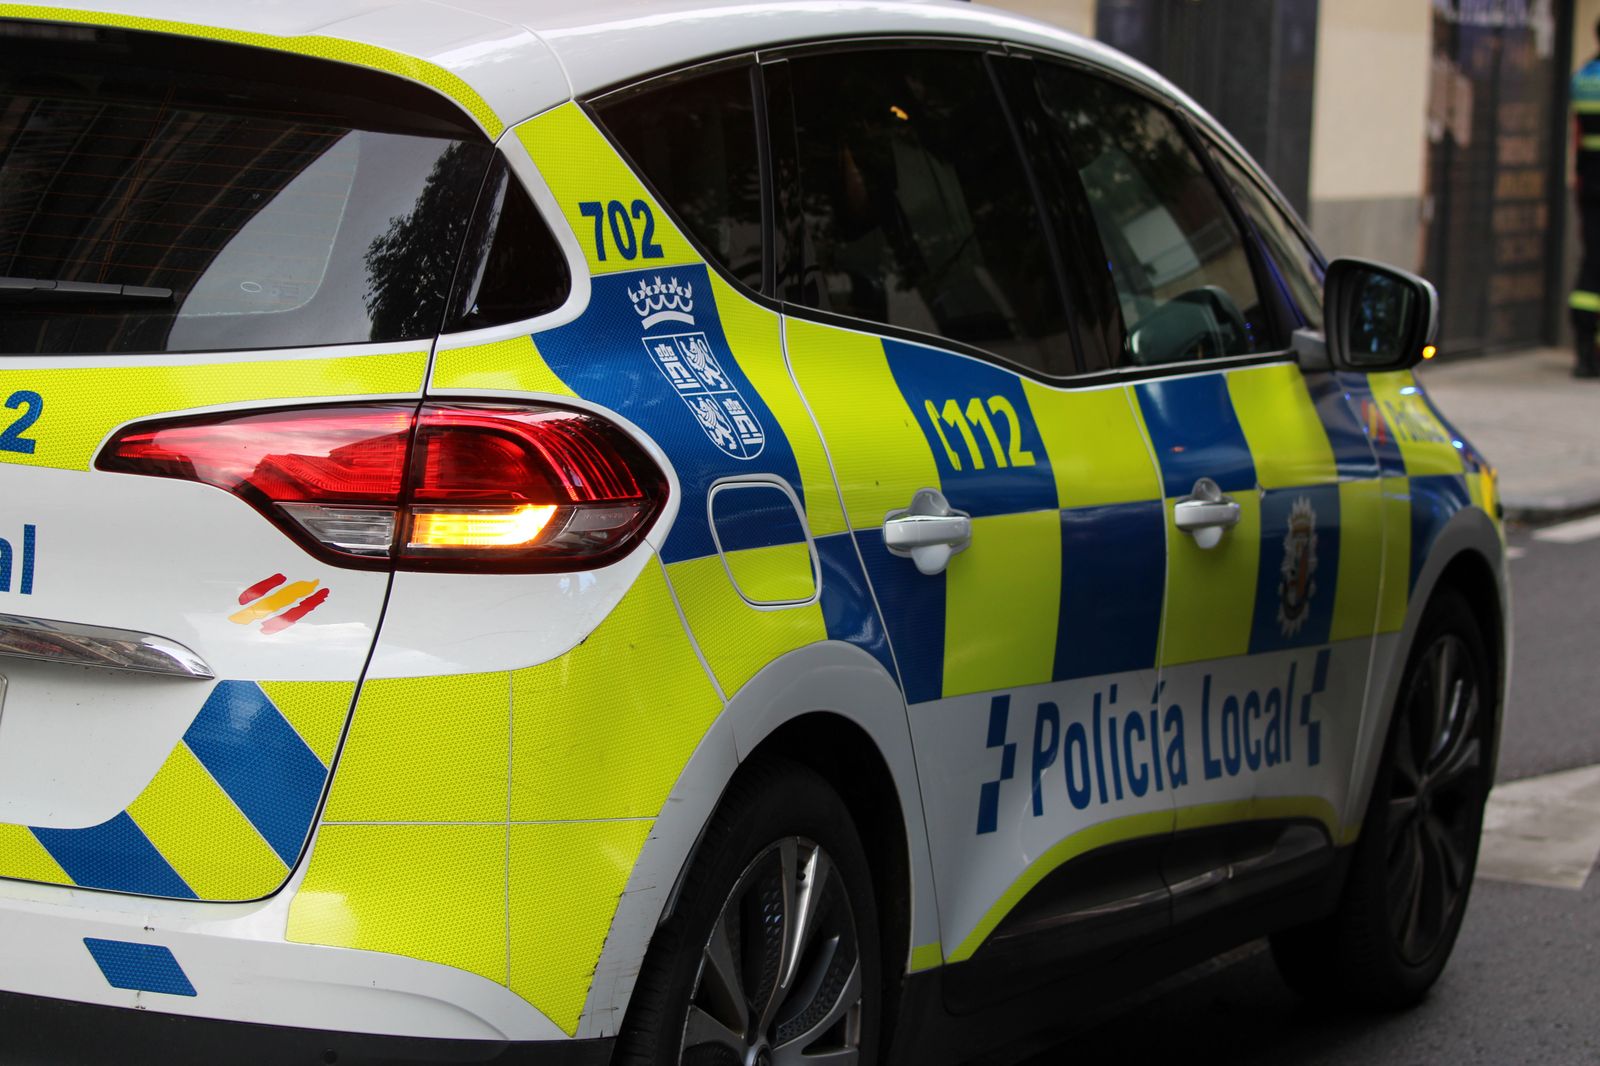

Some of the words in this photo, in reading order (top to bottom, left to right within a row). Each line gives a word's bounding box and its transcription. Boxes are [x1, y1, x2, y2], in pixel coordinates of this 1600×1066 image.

[579, 199, 664, 262] 702
[941, 394, 1036, 471] 112
[1031, 681, 1188, 817] Policía
[1203, 661, 1298, 781] Local
